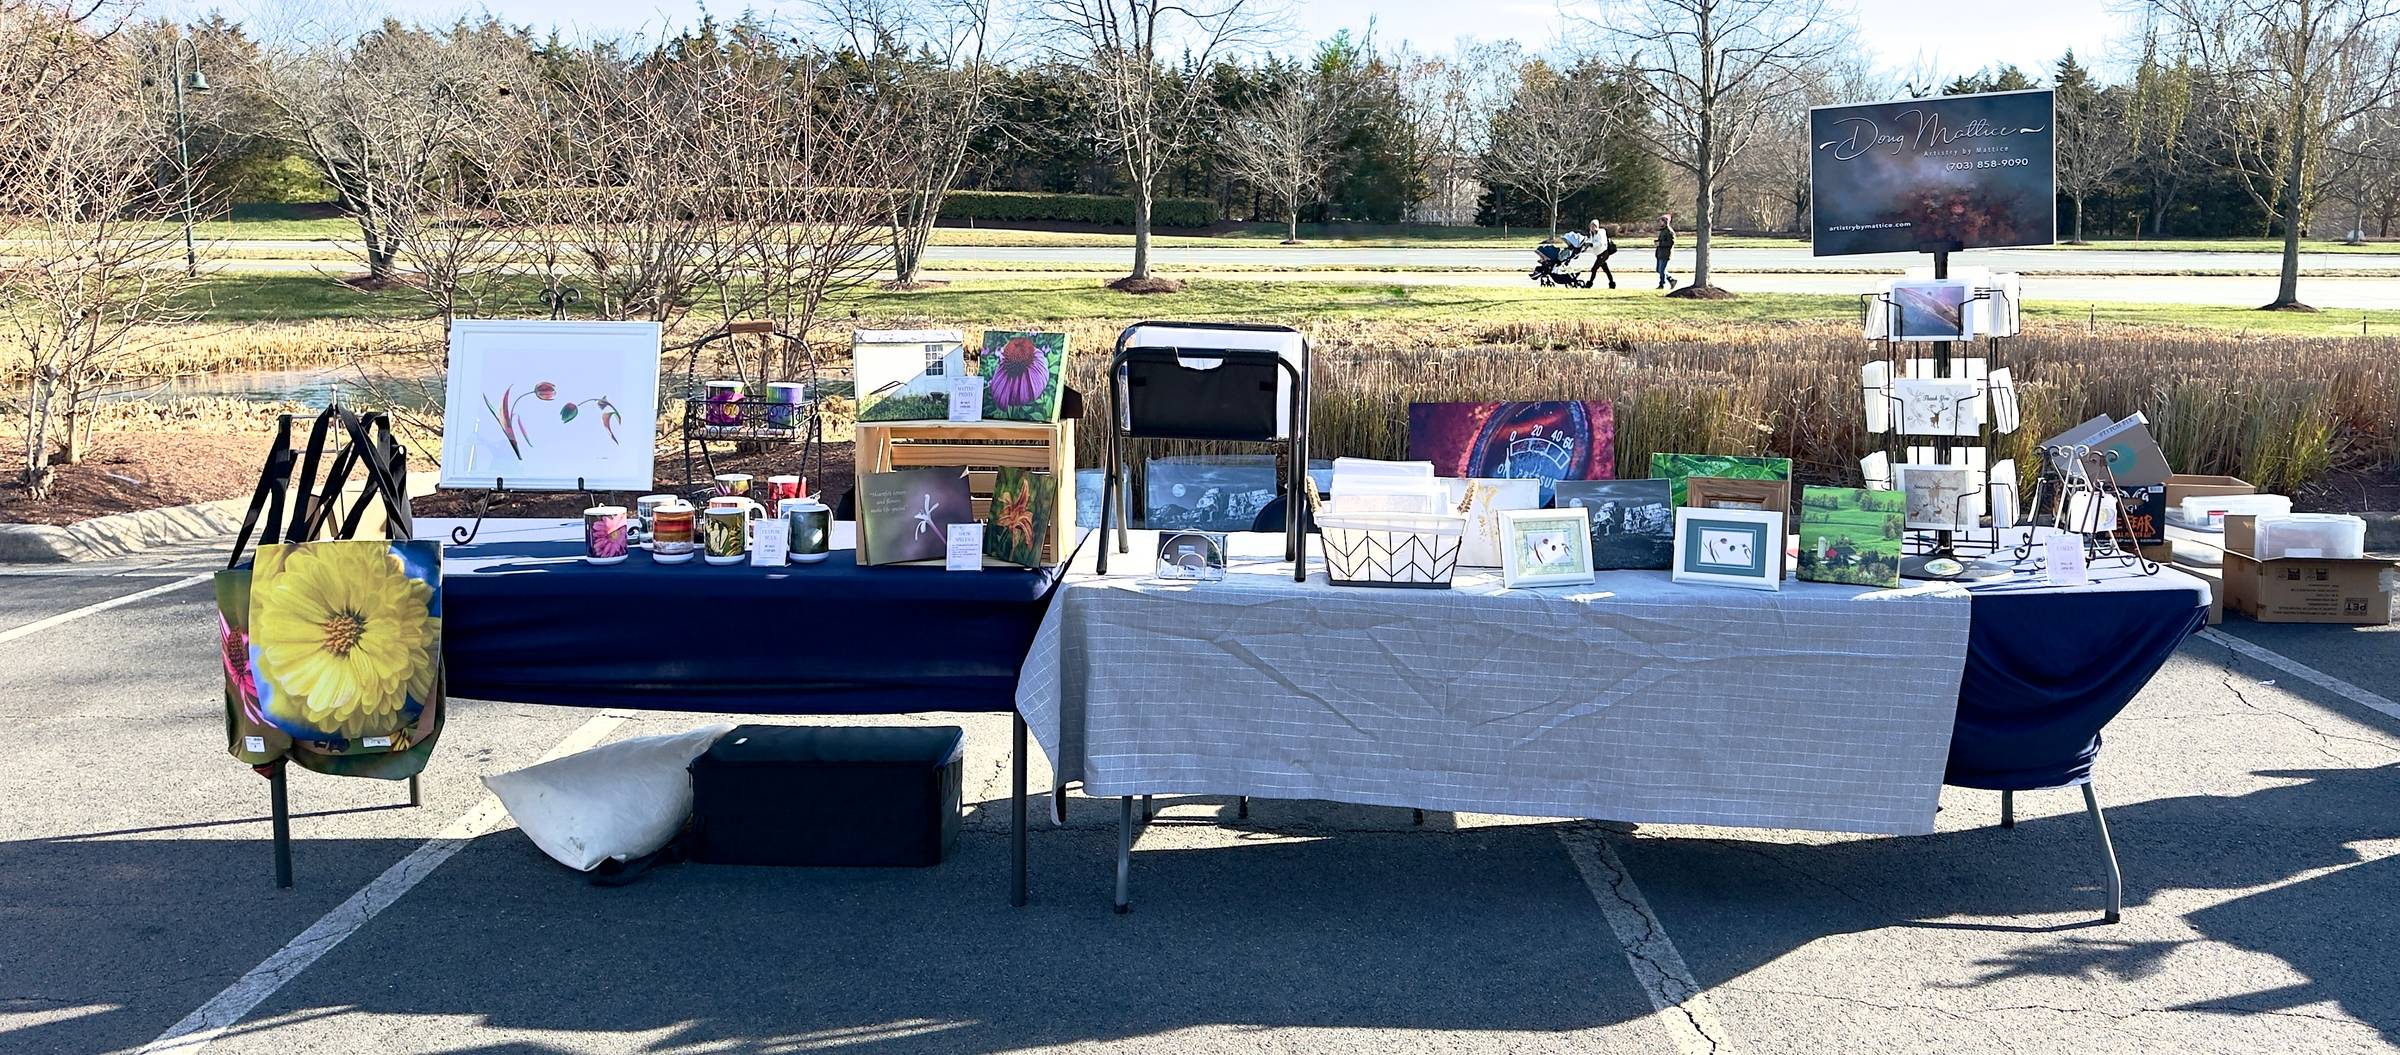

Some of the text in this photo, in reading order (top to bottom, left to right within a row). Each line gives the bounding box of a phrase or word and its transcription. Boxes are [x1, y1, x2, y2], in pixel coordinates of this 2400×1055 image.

[1834, 109, 2017, 161] Doug Mattice
[1923, 149, 1958, 158] Artistry
[1976, 145, 2009, 153] Mattice
[1946, 158, 2029, 171] (703) 858-9090
[1829, 222, 1912, 231] artistrybymattice.com
[1531, 424, 1543, 437] 20
[1551, 430, 1563, 442] 40
